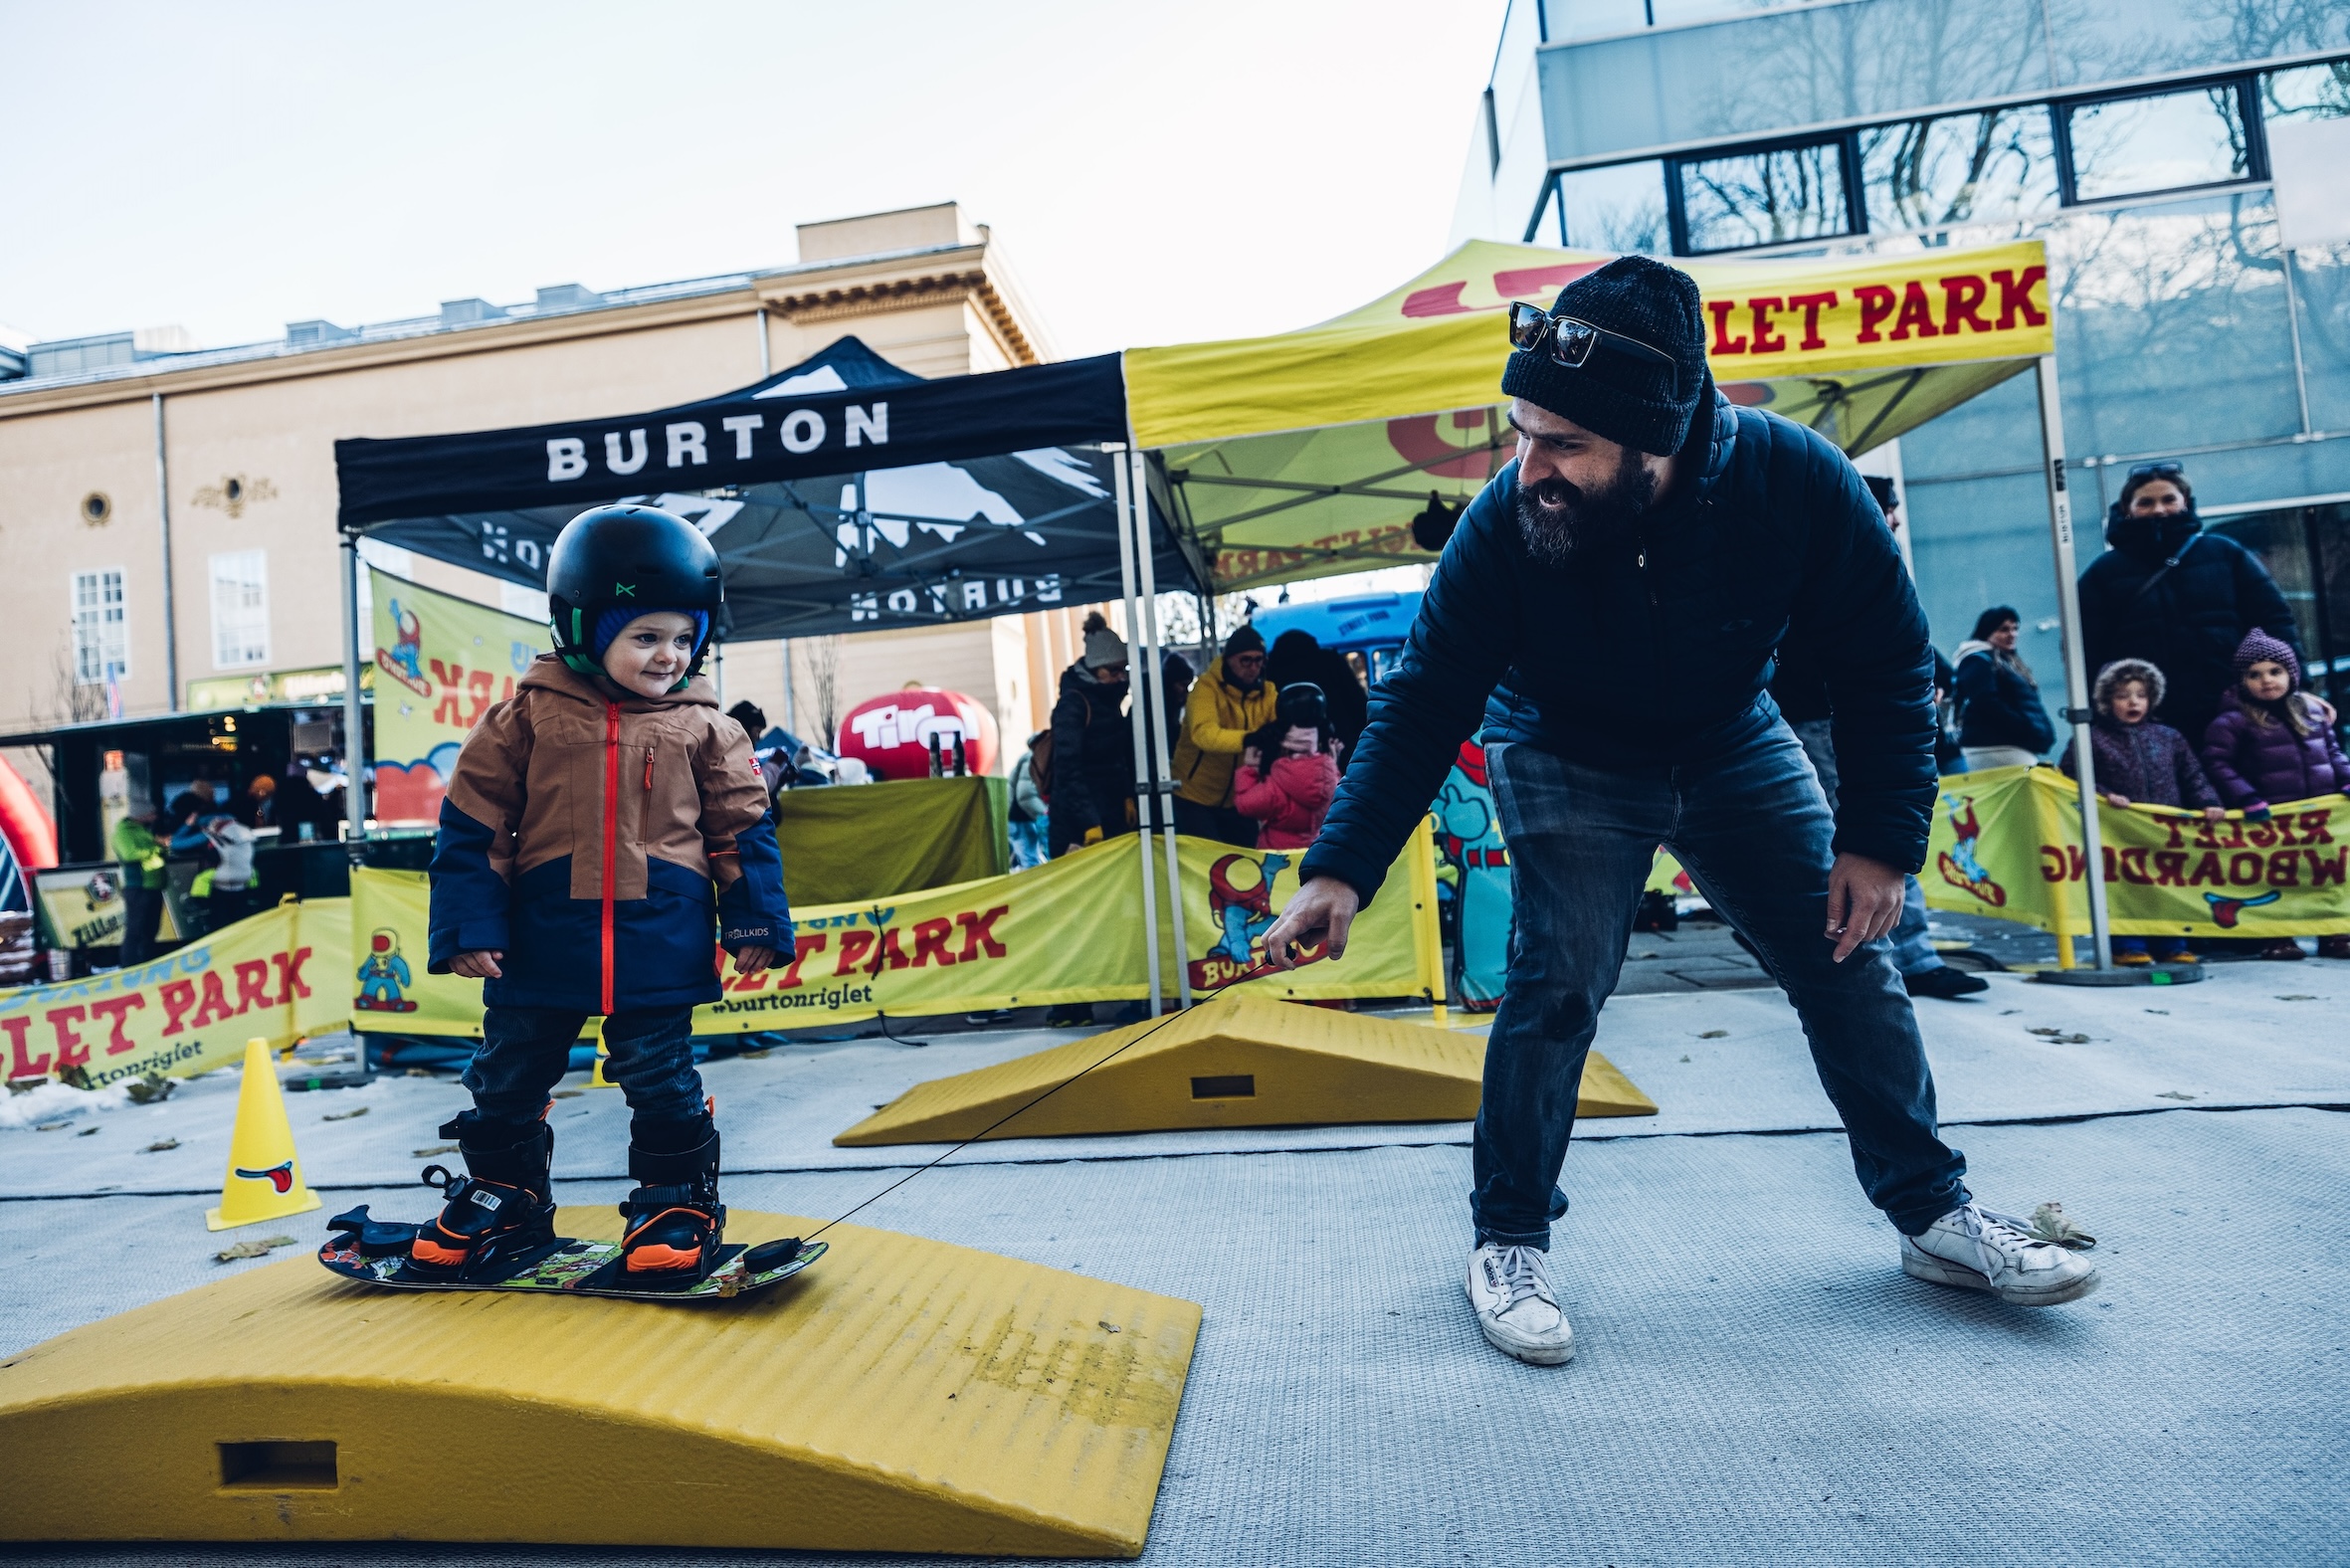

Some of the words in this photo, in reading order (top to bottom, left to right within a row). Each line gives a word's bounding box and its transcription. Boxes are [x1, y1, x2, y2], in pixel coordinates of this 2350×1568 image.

[1708, 291, 1838, 356] LET
[1853, 265, 2047, 343] PARK
[546, 401, 888, 483] BURTON
[852, 701, 981, 750] Tirol
[832, 904, 1009, 977] PARK
[0, 992, 145, 1080] LET
[158, 946, 312, 1037] PARK
[88, 1040, 202, 1090] rtonriglet
